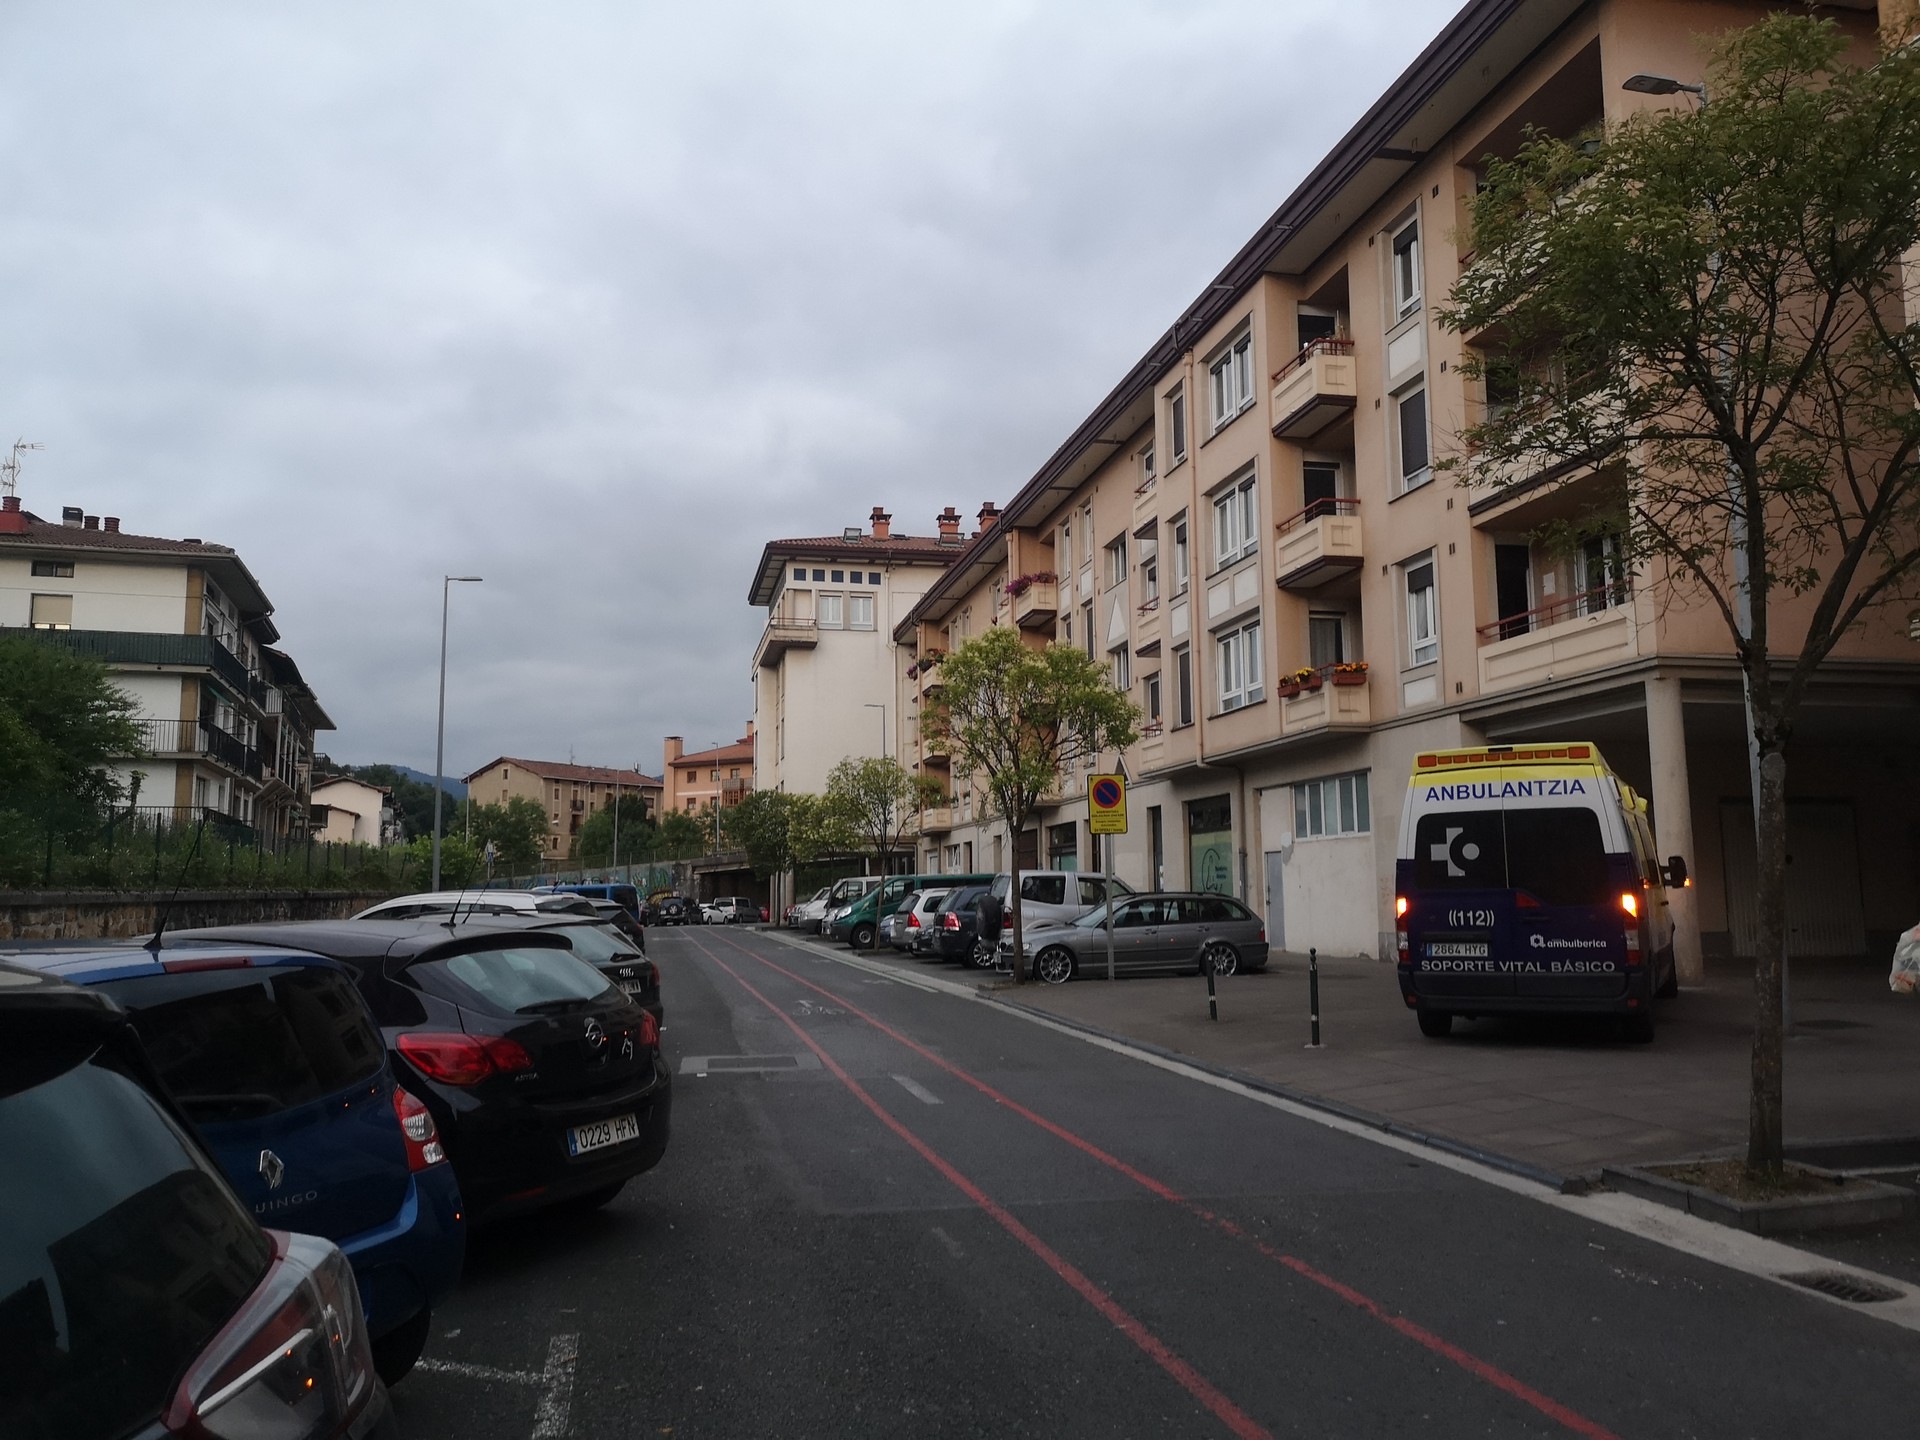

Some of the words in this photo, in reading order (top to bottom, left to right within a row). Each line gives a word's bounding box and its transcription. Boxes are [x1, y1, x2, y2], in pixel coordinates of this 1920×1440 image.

[1425, 778, 1587, 802] ANBULANTZIA
[1421, 960, 1495, 972] SOPORTE
[1499, 960, 1546, 973] VITAL
[1551, 958, 1615, 973] BÁSICO
[579, 1123, 611, 1149] 0229
[613, 1115, 637, 1140] HFN
[255, 1189, 318, 1214] UINGO
